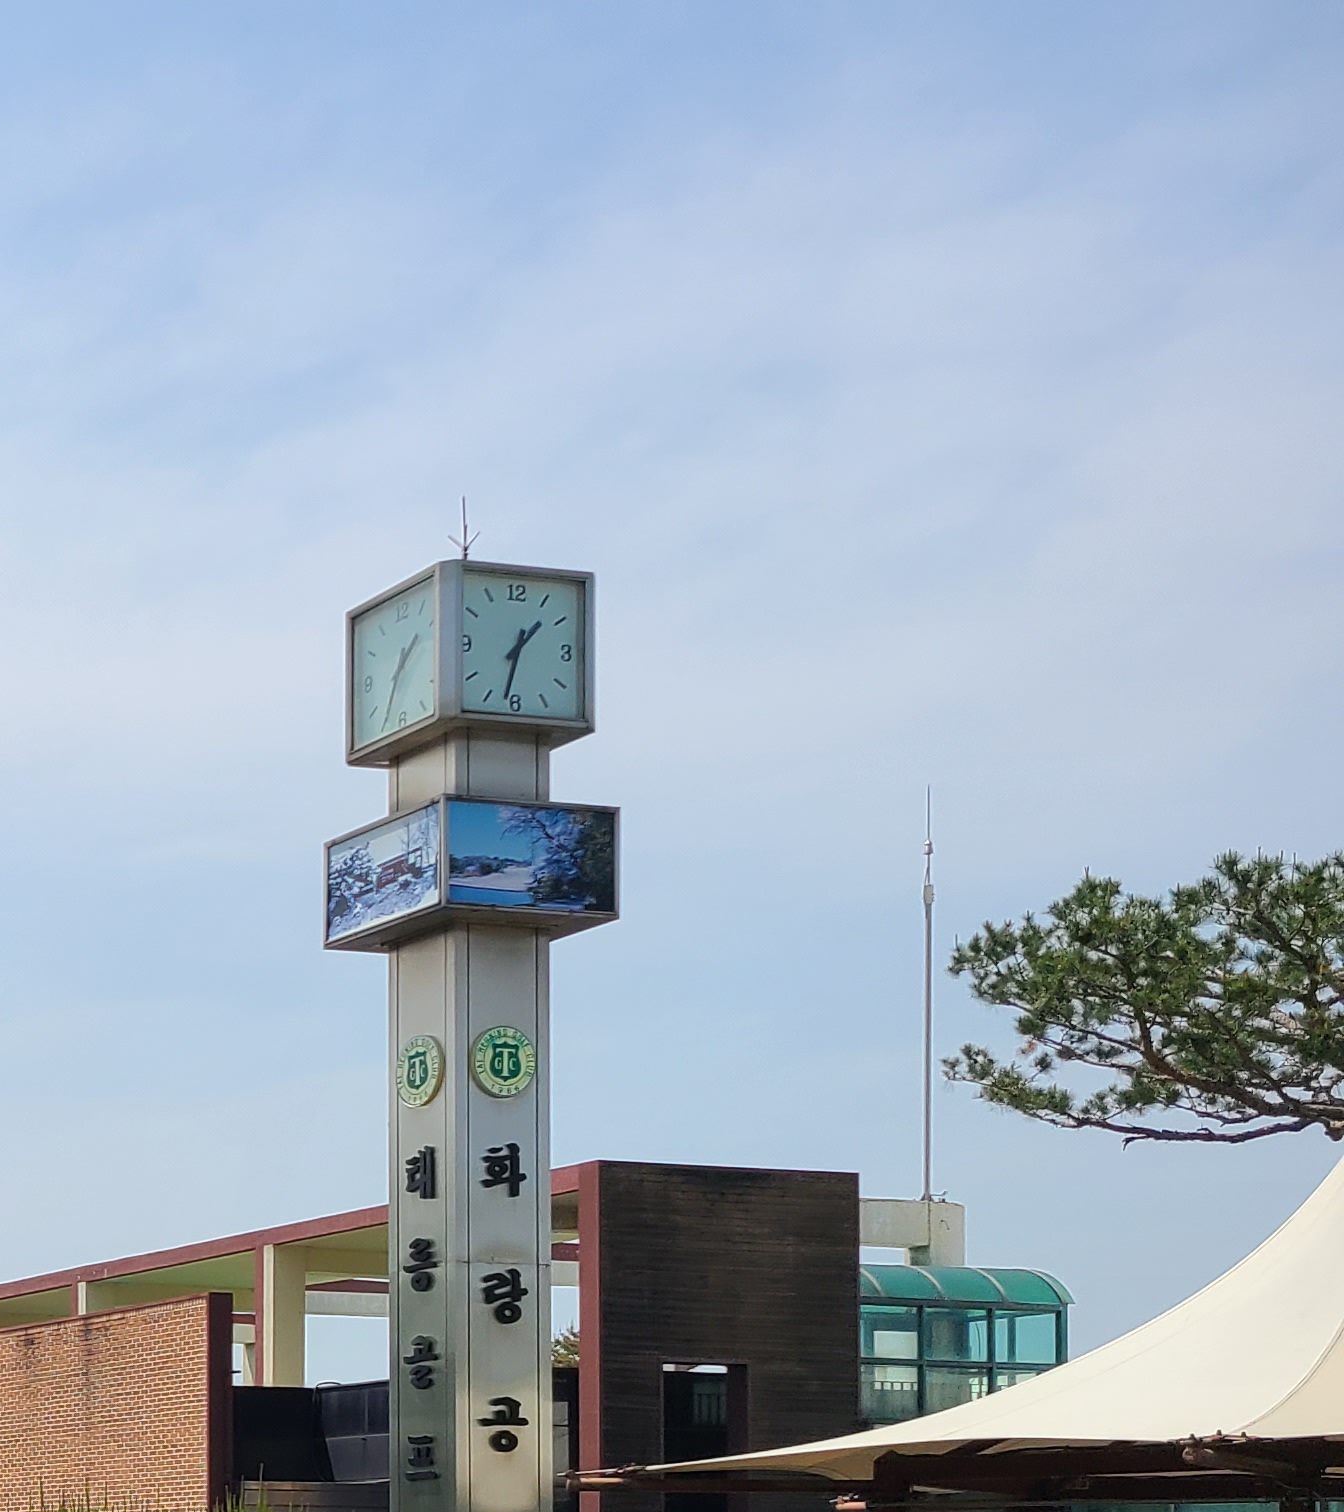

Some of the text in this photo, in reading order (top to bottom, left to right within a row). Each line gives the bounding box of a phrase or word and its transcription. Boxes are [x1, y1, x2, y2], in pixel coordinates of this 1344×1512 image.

[507, 584, 526, 602] 12
[395, 602, 409, 623] 12
[560, 644, 572, 662] 3
[364, 675, 373, 693] 9
[509, 694, 521, 712] 6
